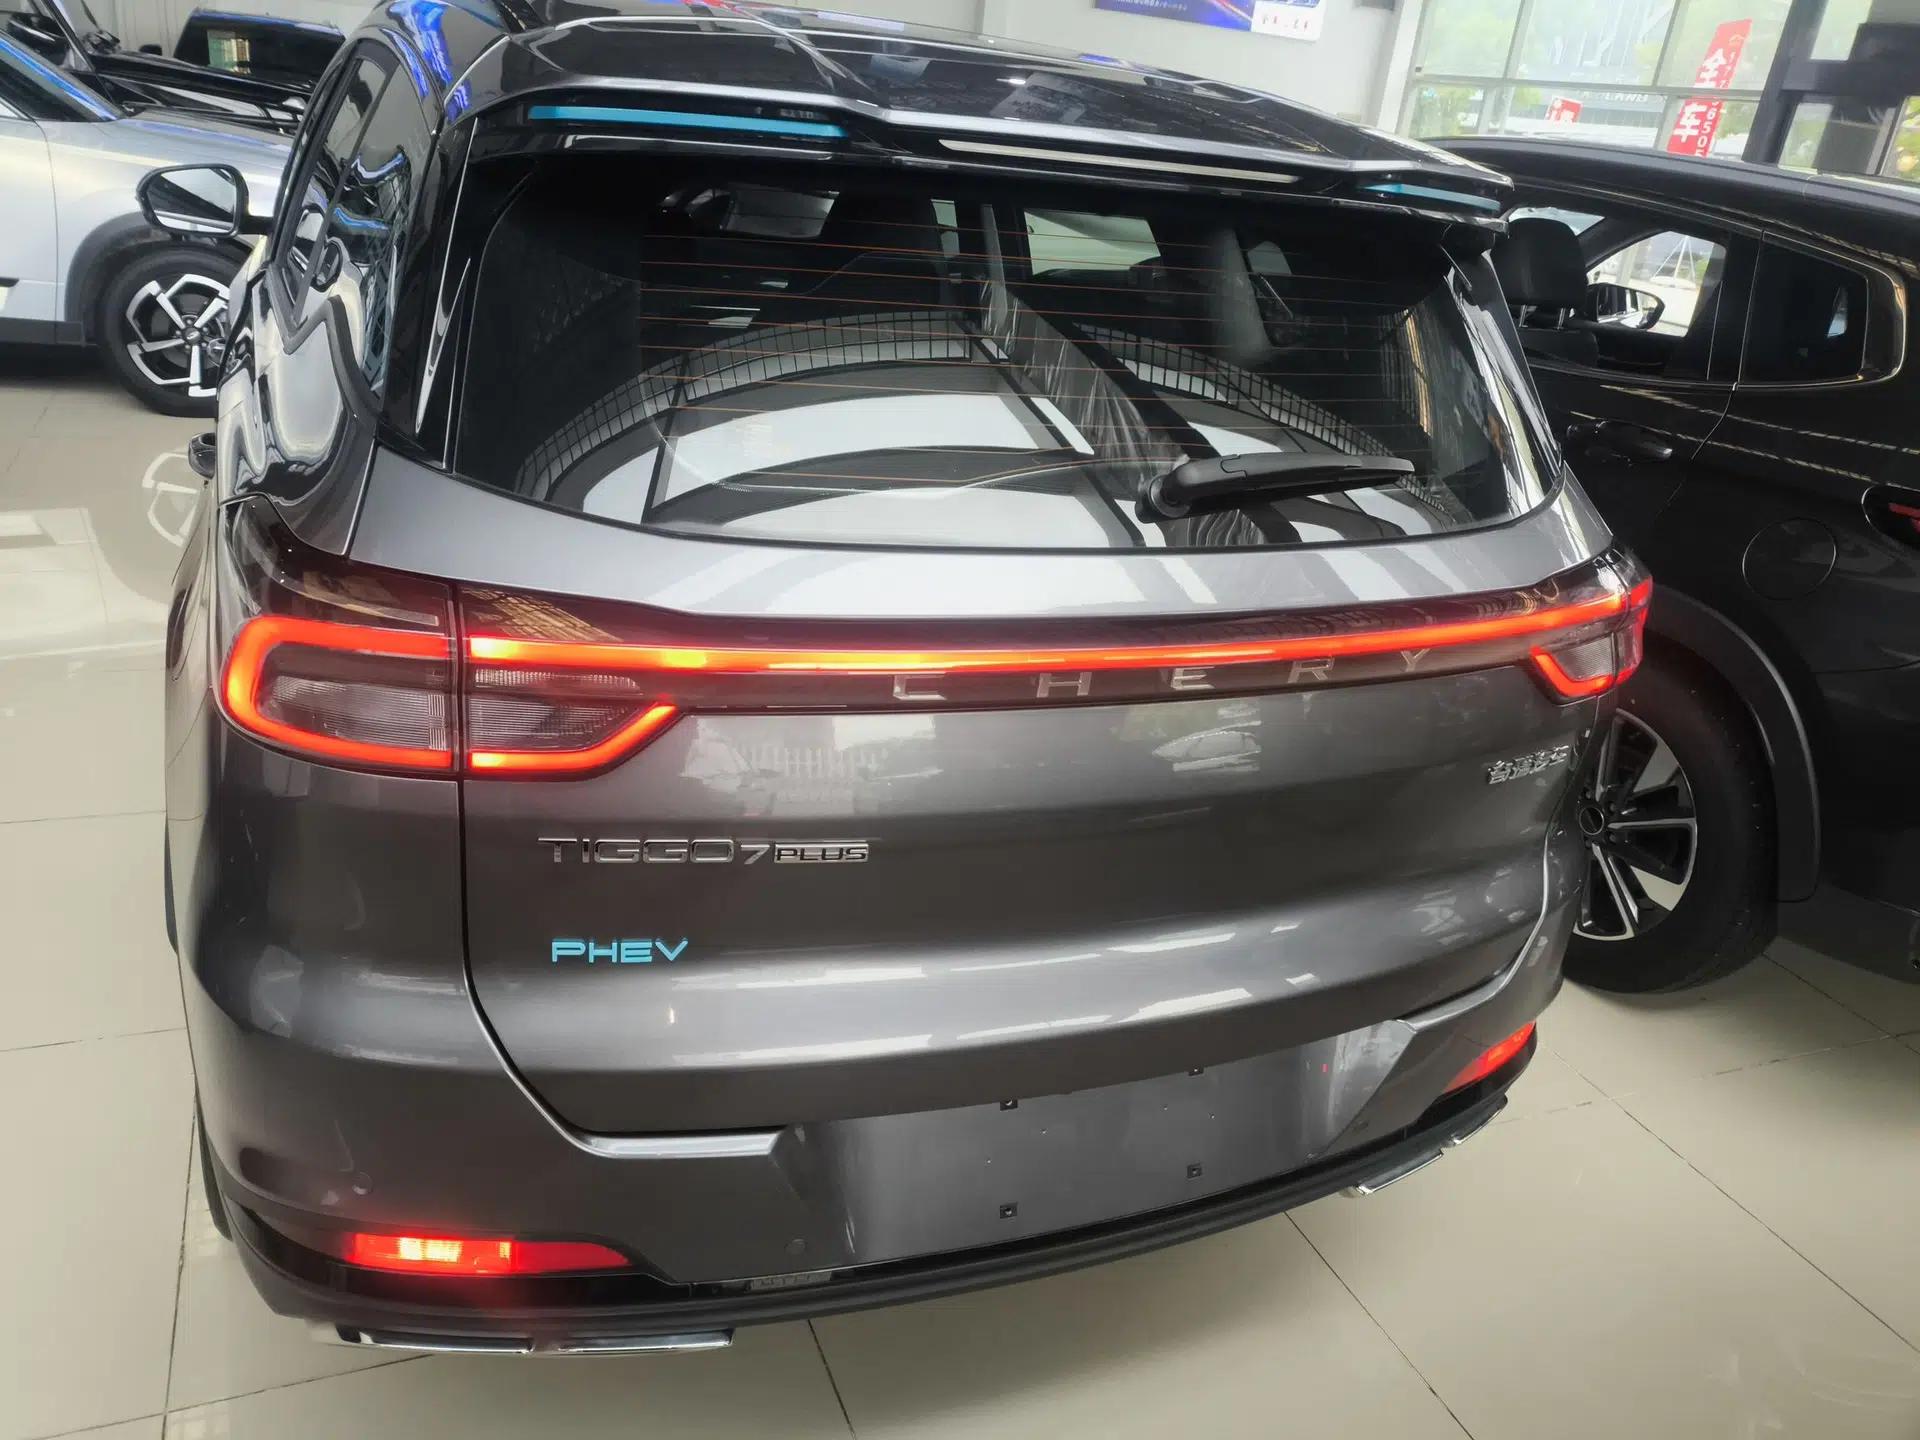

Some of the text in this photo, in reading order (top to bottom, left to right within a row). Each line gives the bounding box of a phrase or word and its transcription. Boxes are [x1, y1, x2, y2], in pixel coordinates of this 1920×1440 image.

[892, 648, 1431, 701] CHERY
[776, 846, 868, 862] PLUS
[551, 938, 689, 963] PHEV
